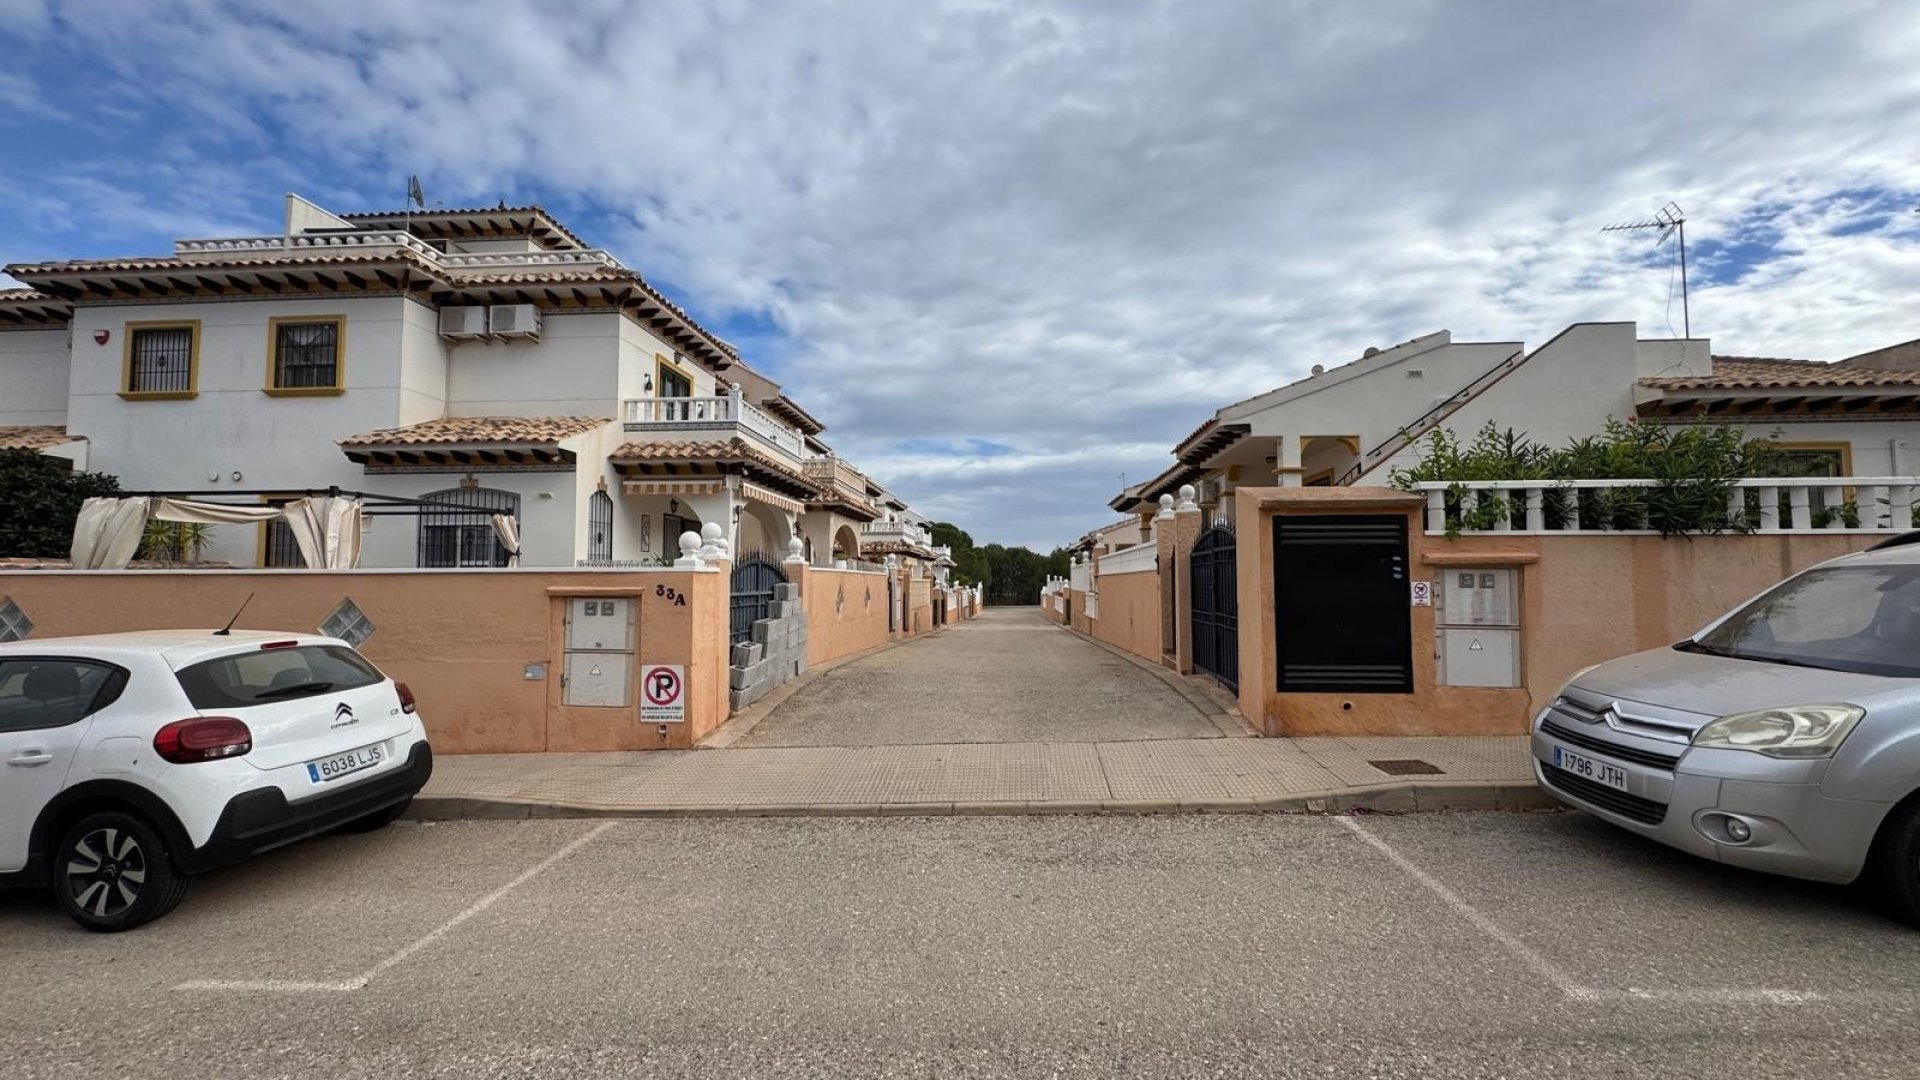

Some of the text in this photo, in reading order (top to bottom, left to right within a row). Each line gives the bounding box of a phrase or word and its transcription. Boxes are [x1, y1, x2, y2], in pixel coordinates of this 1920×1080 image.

[656, 584, 686, 606] 33A
[321, 747, 381, 776] 6038 LJS
[1564, 753, 1624, 787] 1796 JTH
